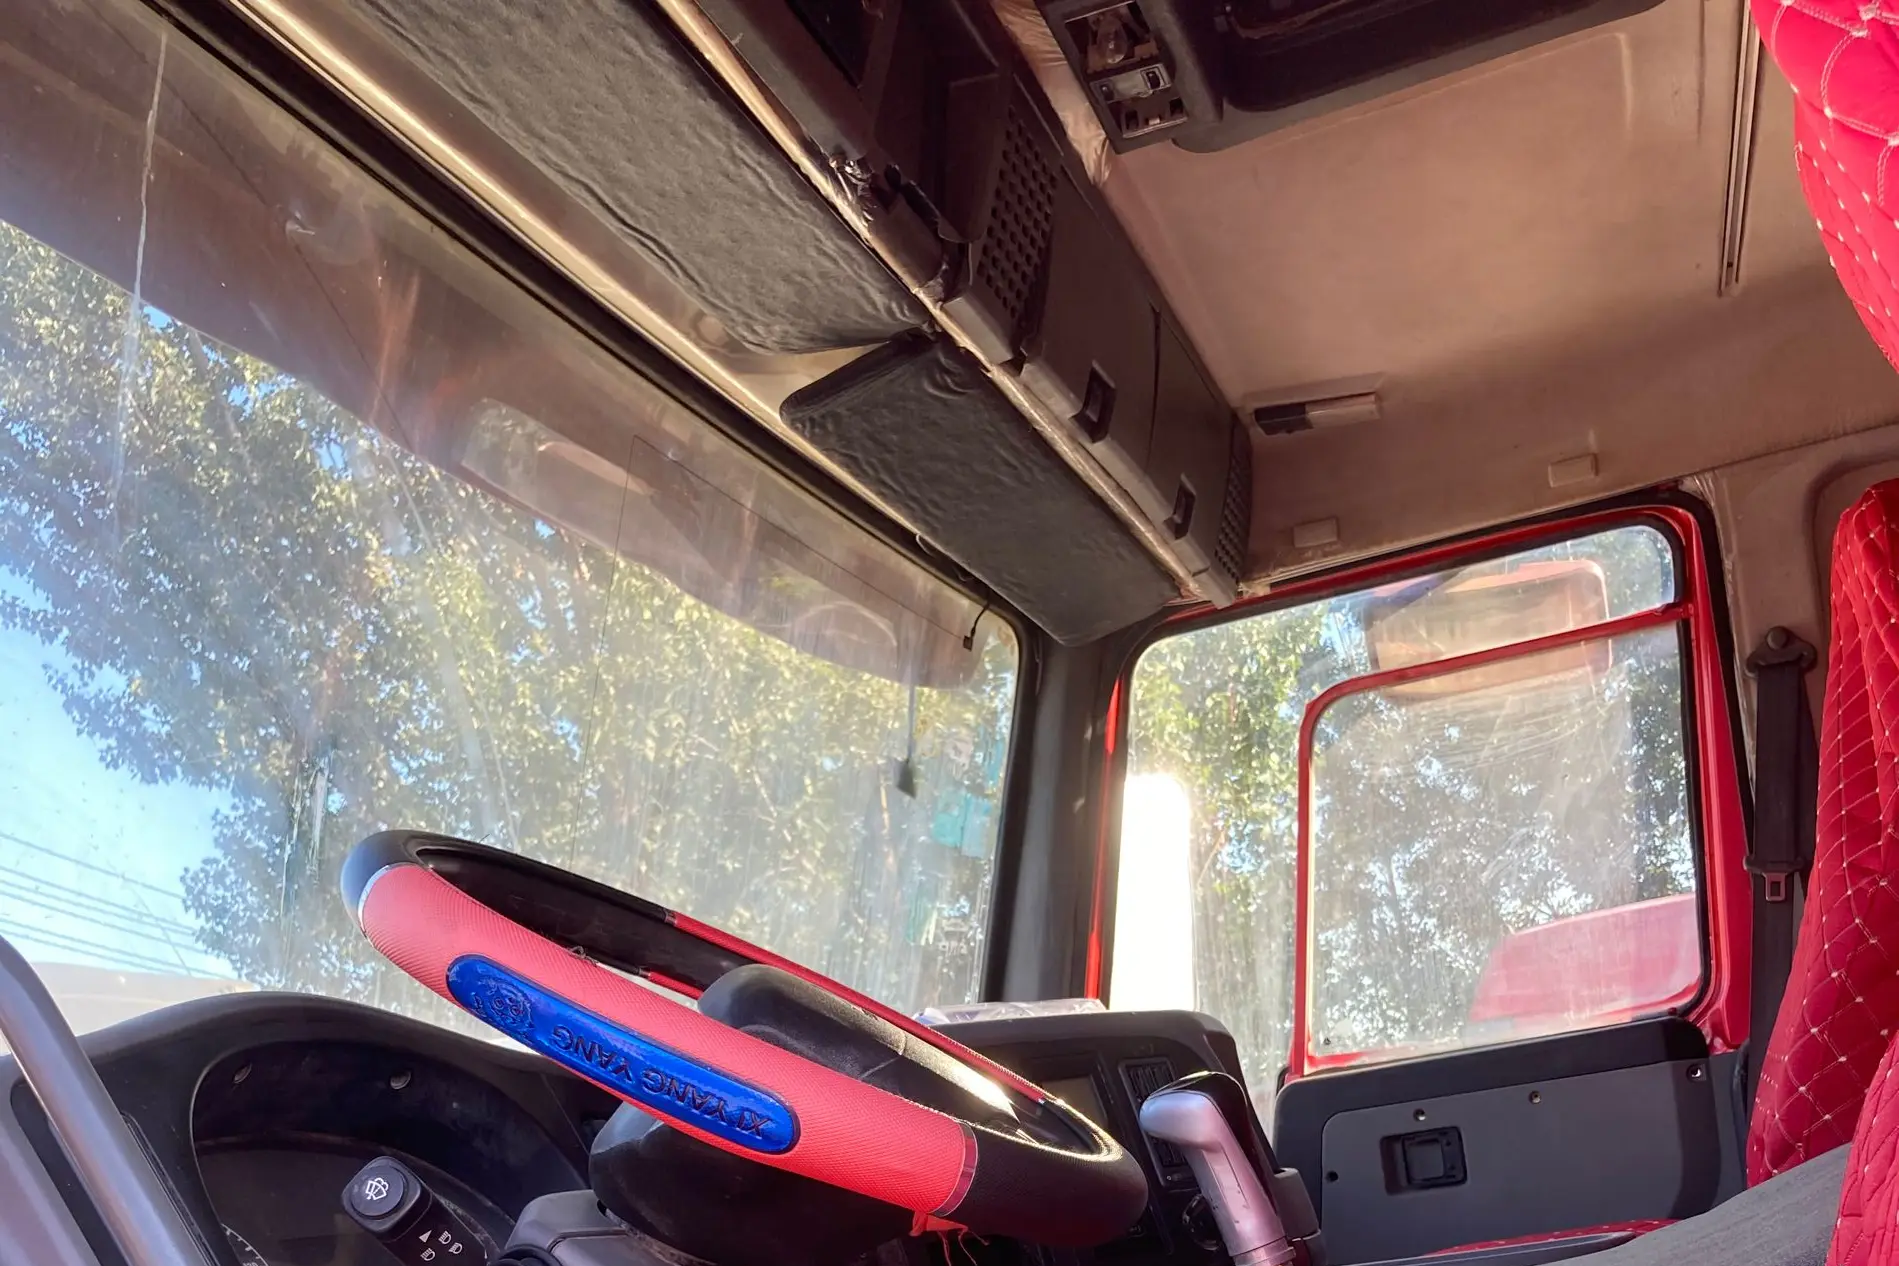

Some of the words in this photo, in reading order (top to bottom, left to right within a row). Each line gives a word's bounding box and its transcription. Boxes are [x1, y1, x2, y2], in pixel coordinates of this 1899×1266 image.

[551, 1023, 635, 1084] YANG
[641, 1066, 729, 1124] YANG
[735, 1108, 772, 1139] XI
